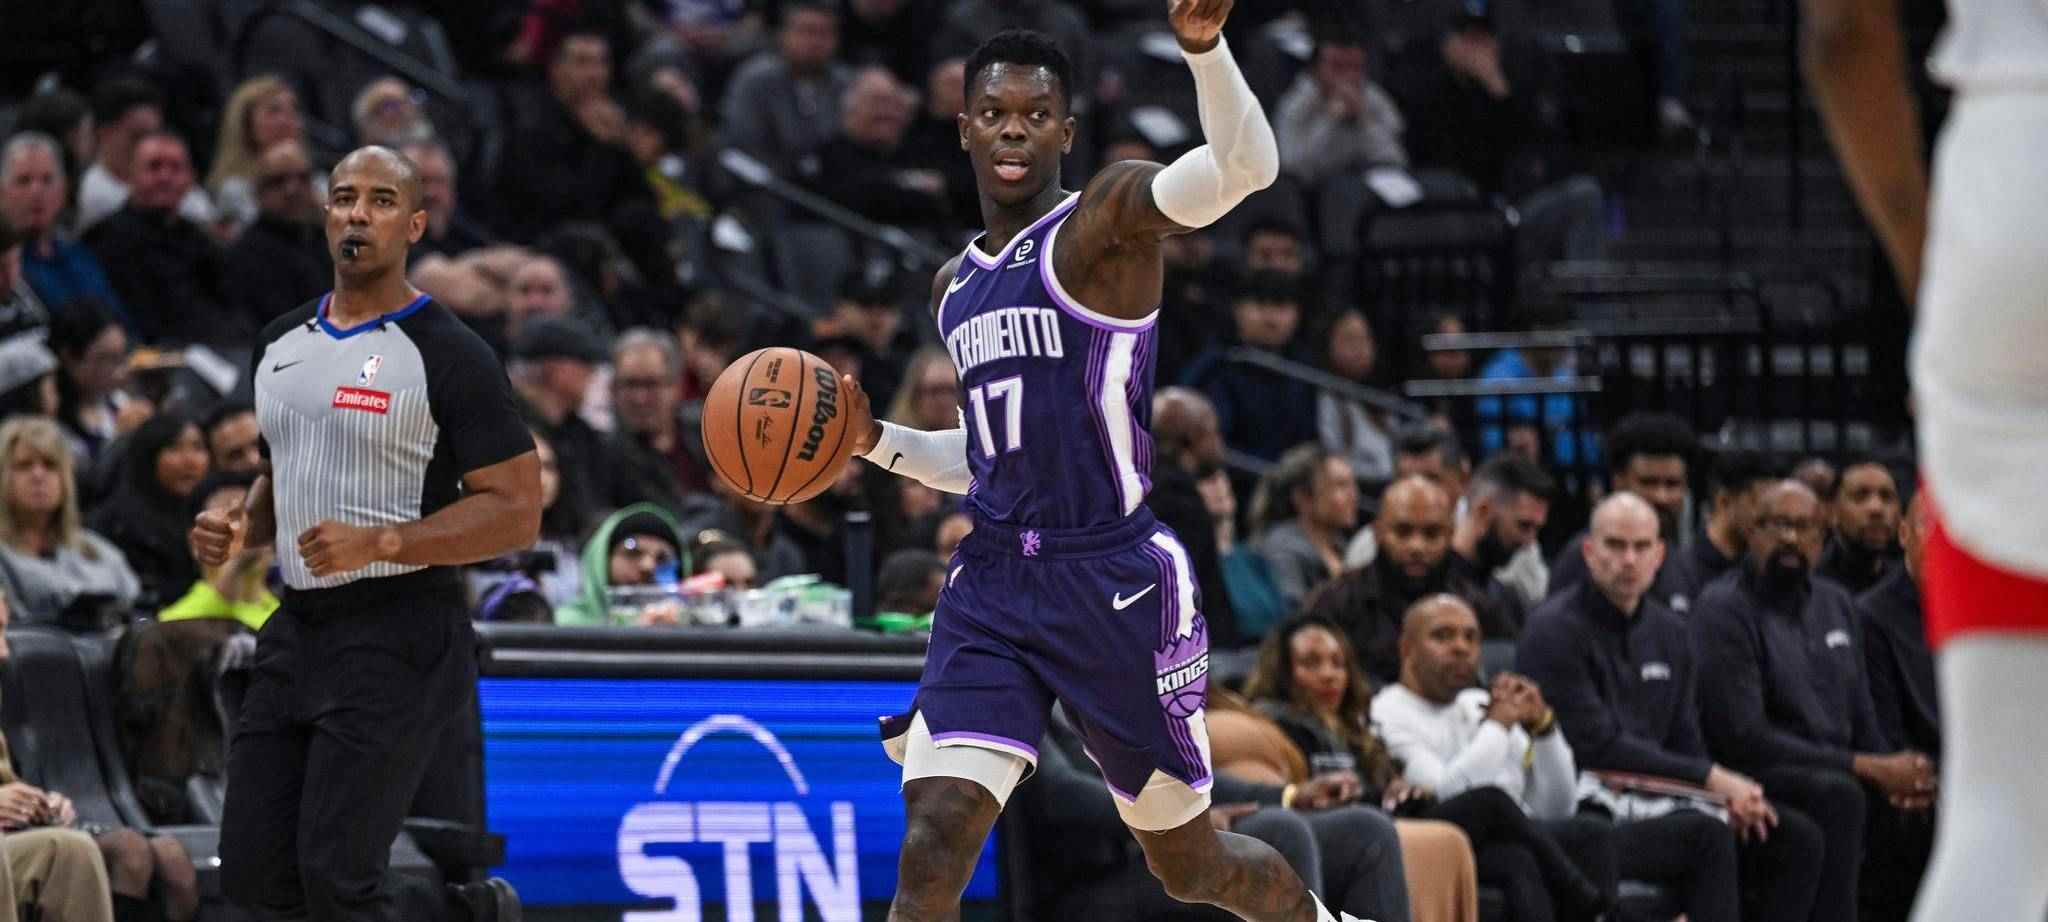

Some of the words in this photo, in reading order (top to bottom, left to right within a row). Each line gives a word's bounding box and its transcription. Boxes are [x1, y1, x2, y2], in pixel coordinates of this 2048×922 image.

[947, 307, 1064, 383] CRAMENTO
[335, 390, 388, 410] Emirates
[797, 366, 838, 461] Wilson
[968, 376, 1023, 459] 17
[1156, 653, 1209, 696] KINGS
[617, 801, 862, 922] STN
